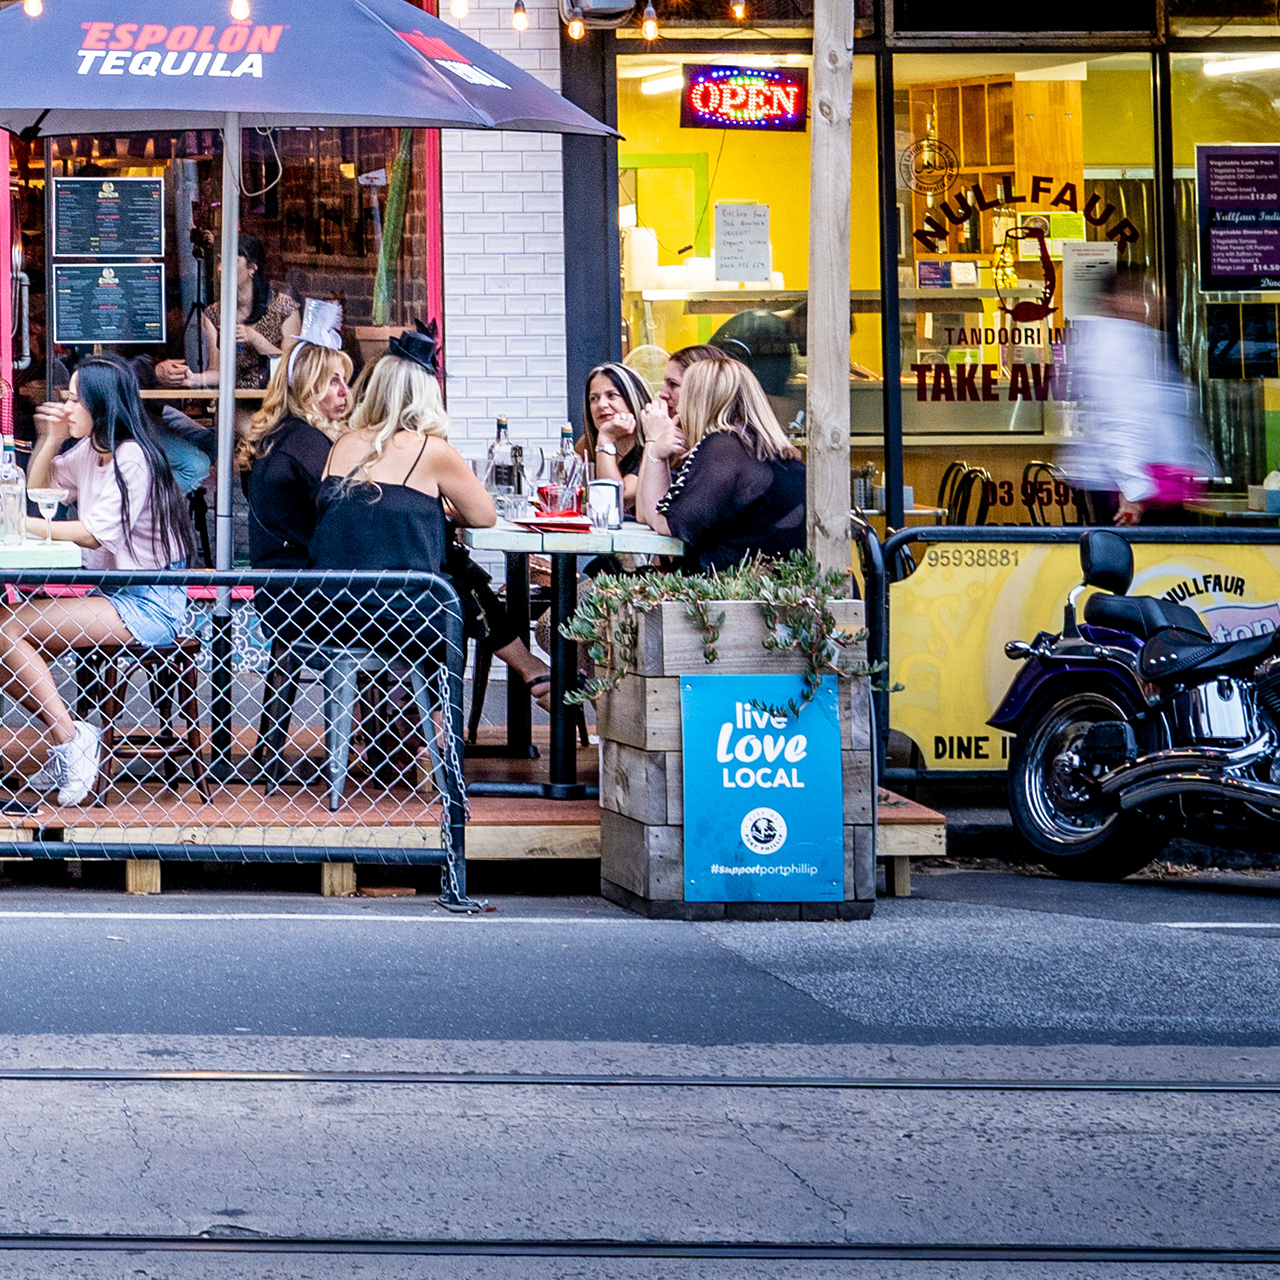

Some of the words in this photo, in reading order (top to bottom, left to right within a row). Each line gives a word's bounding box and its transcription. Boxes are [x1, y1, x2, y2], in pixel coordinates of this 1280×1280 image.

[77, 49, 263, 78] TEQUILA
[691, 81, 799, 115] OPEN
[1250, 193, 1278, 201] $12.00
[913, 176, 1140, 255] NULLFAUR
[1212, 211, 1256, 224] Nullfaur
[1252, 264, 1280, 272] $14.50
[944, 327, 1041, 345] TANDOORI
[910, 363, 1000, 402] TAKE
[982, 480, 1015, 507] 03
[926, 548, 1019, 568] 95938881
[1161, 573, 1246, 605] NULLFAUR
[735, 701, 788, 730] live
[934, 736, 990, 760] DINE
[722, 767, 805, 789] LOCAL
[744, 833, 758, 849] PORT
[760, 833, 783, 851] PHILLIP
[710, 863, 818, 877] #supportportphillip
